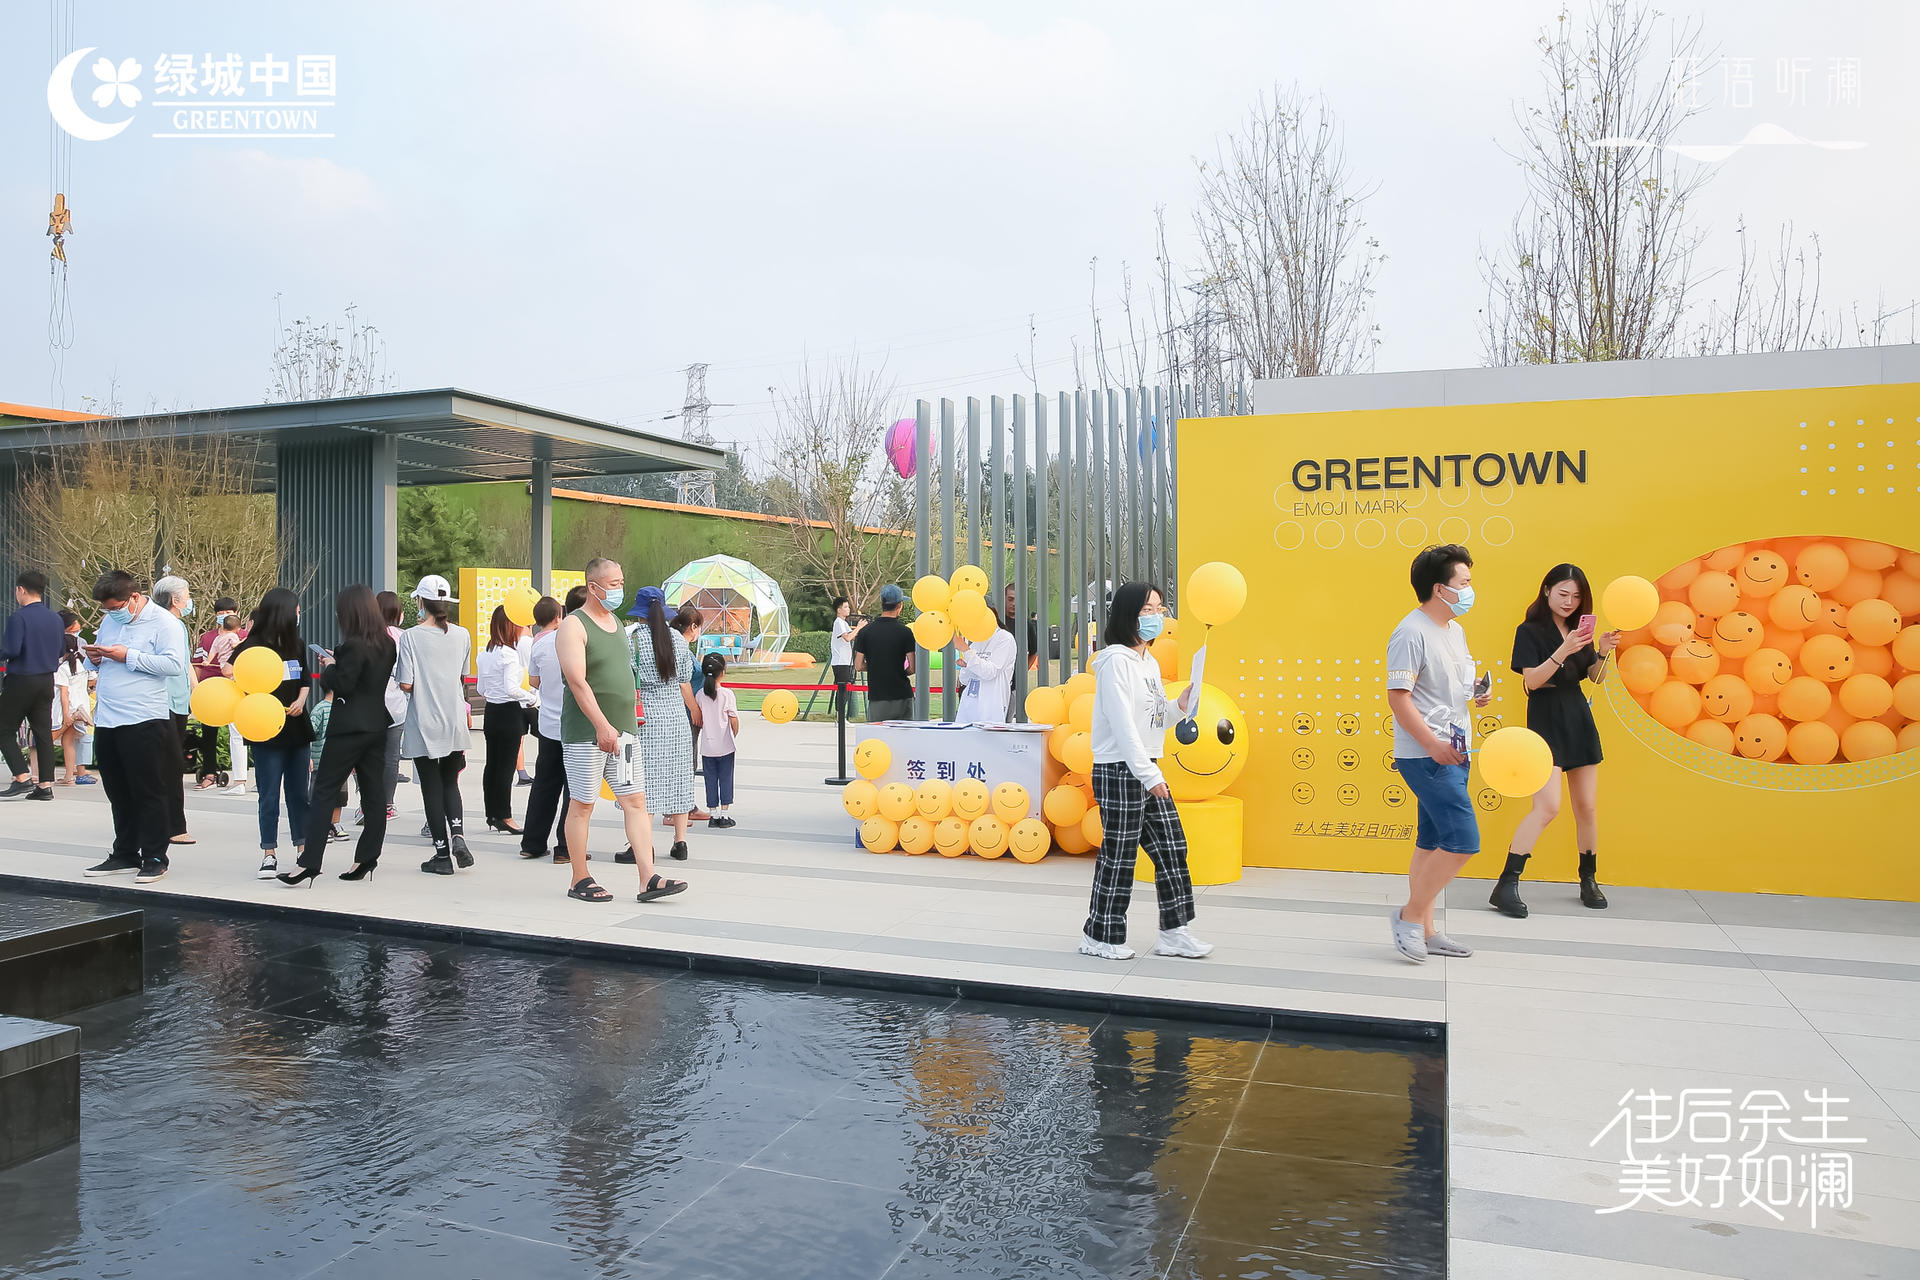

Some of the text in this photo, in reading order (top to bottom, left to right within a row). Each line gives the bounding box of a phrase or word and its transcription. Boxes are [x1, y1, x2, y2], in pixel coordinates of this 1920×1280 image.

[1292, 449, 1587, 492] GREENTOWN
[1293, 499, 1409, 517] EMOJI MARK
[906, 759, 987, 782] 签到处
